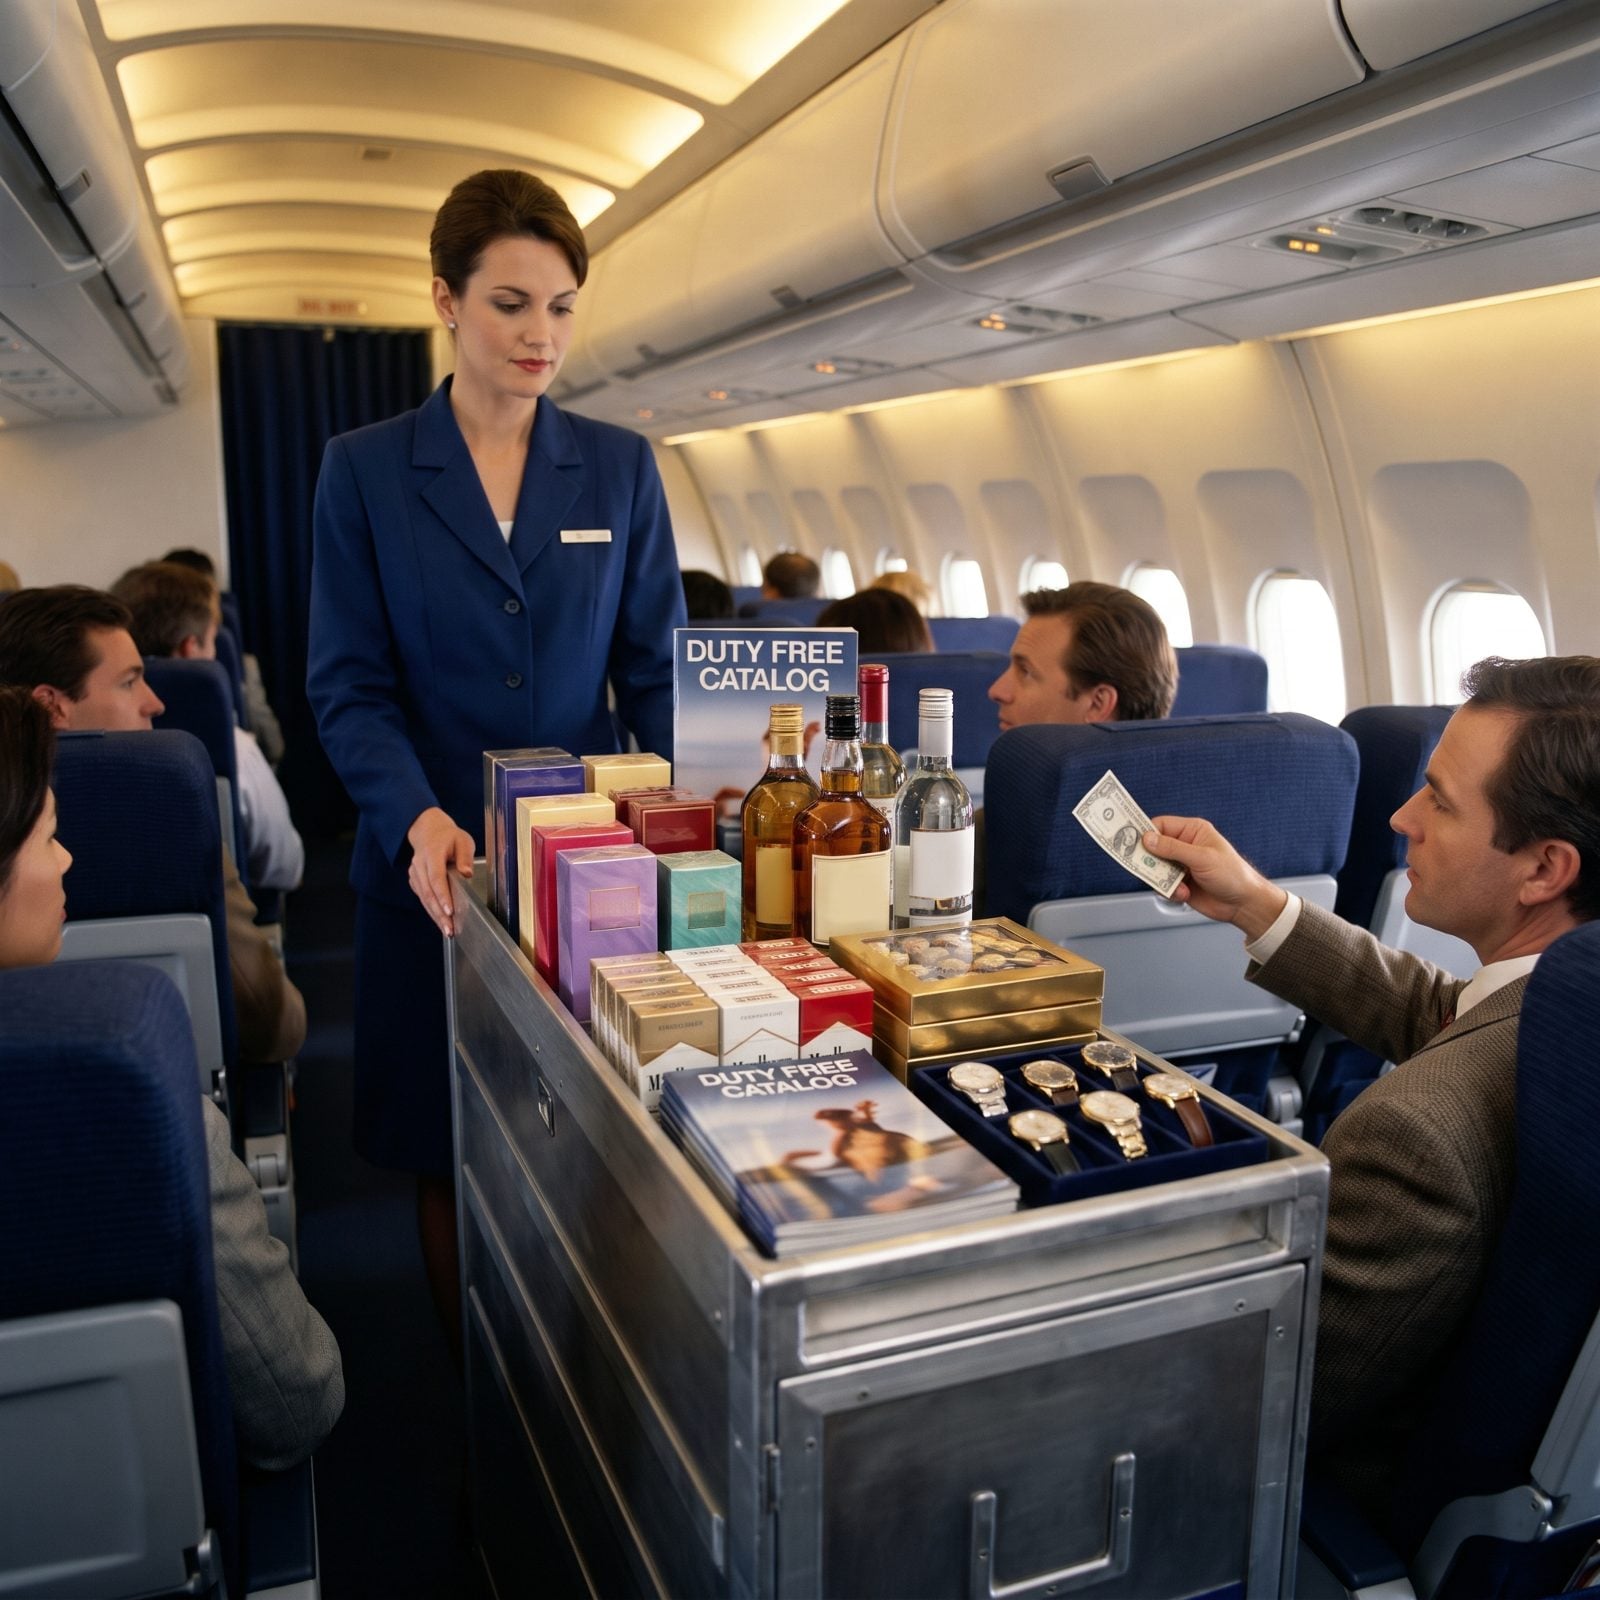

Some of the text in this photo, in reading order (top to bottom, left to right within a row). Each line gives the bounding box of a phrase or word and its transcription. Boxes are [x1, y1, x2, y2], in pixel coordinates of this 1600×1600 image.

[686, 639, 844, 664] DUTY FREE
[699, 667, 830, 692] CATALOG
[698, 1068, 775, 1087] DUTY
[780, 1059, 859, 1078] FREE
[721, 1074, 858, 1098] CATALOG
